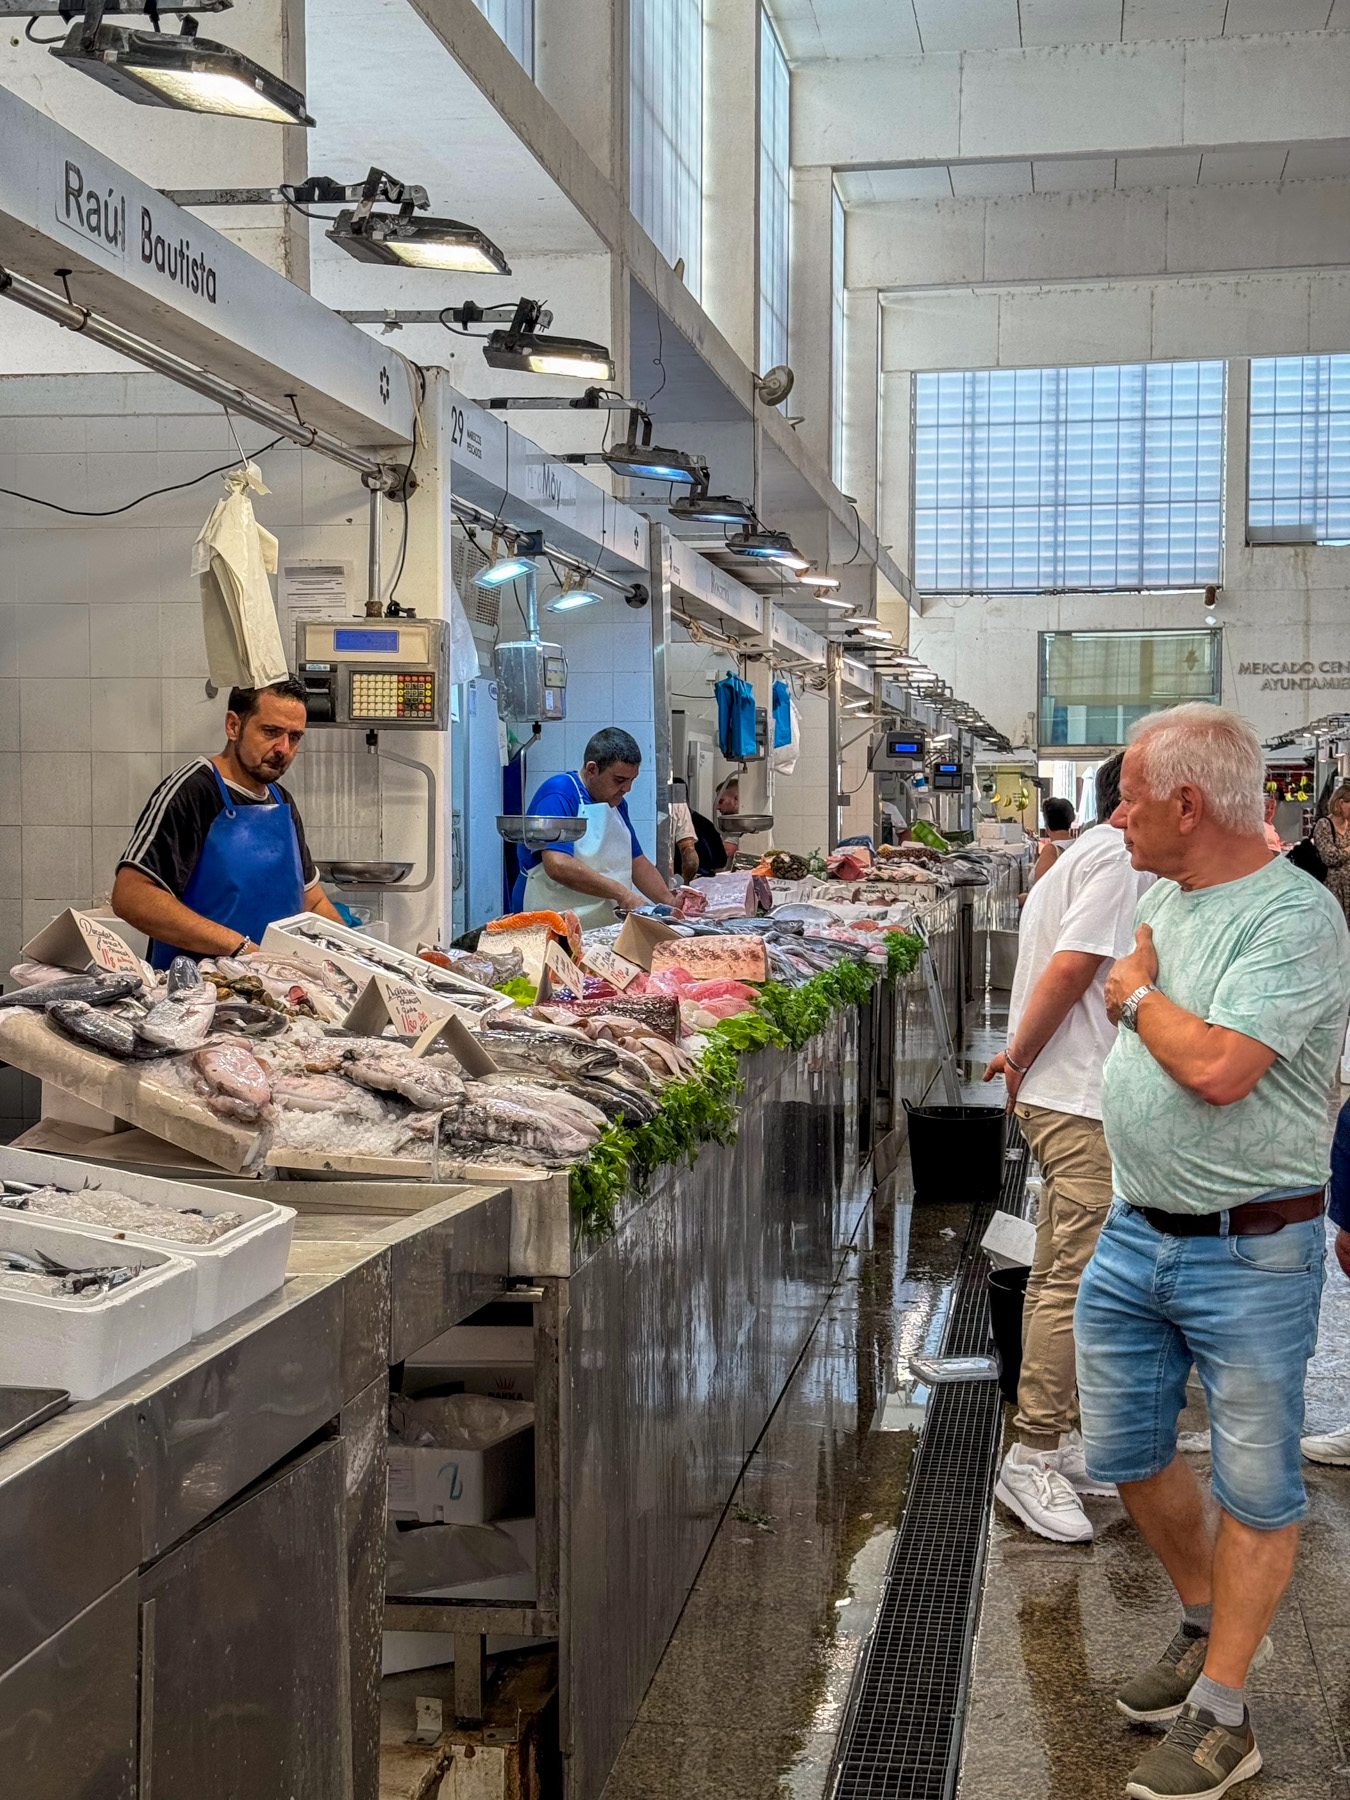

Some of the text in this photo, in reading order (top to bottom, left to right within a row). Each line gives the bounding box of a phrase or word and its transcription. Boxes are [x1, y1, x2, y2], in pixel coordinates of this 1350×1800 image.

[65, 159, 217, 304] Raúl Bautista
[451, 405, 464, 448] 29
[1238, 661, 1315, 675] MERCADO
